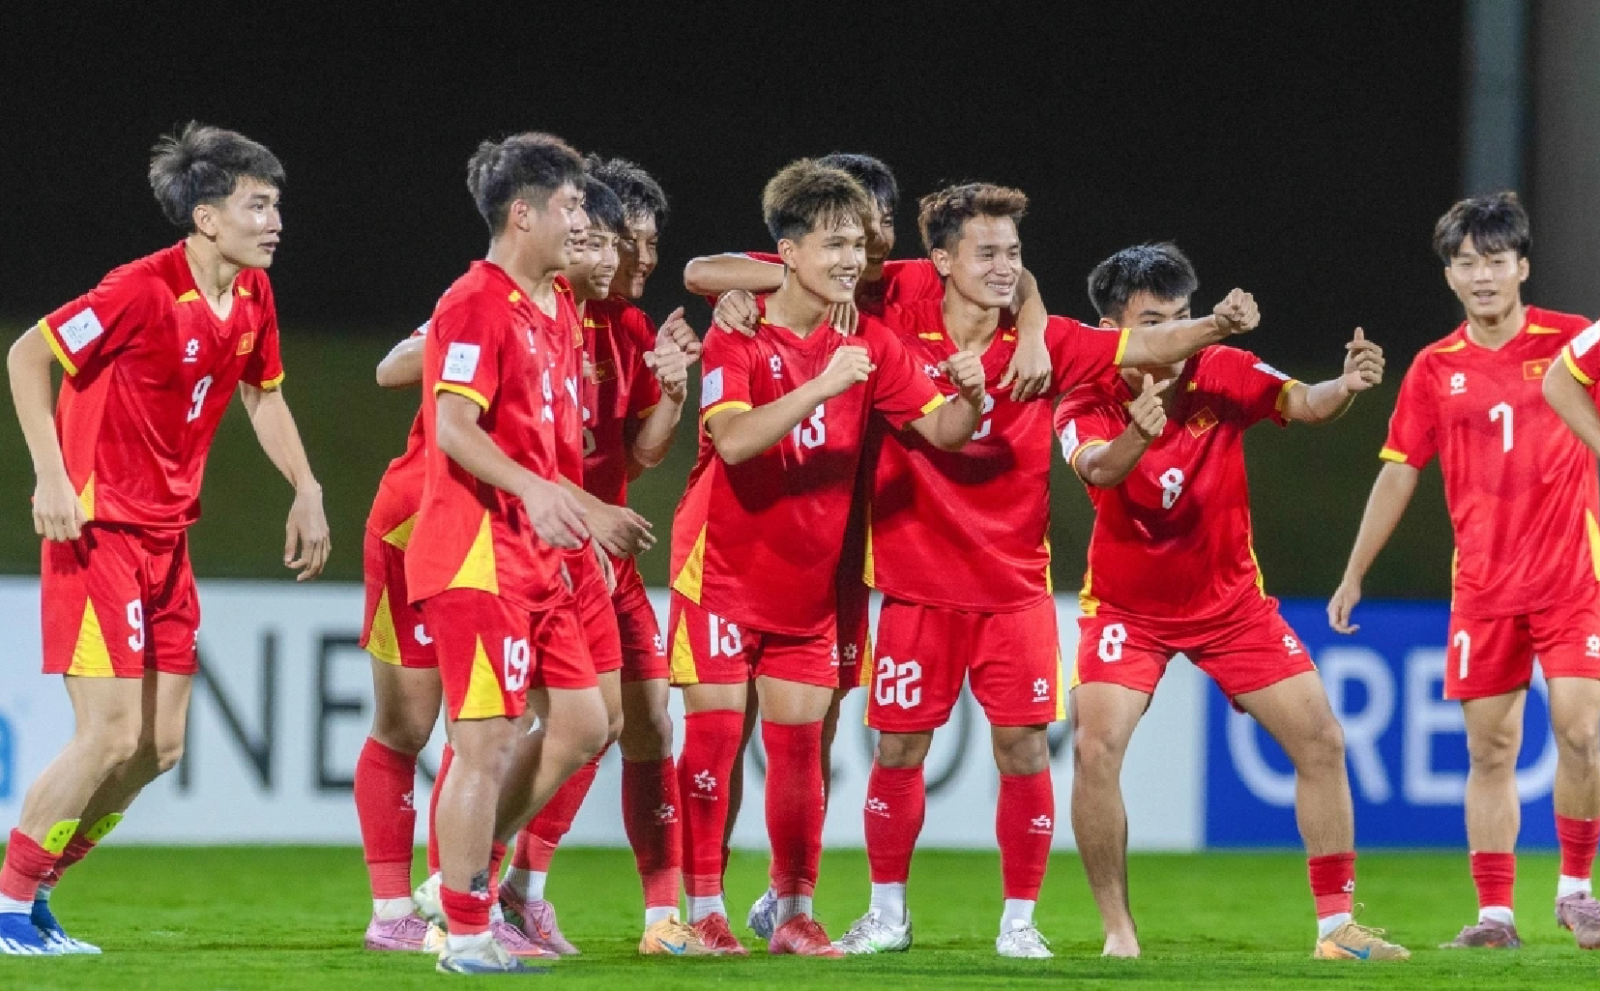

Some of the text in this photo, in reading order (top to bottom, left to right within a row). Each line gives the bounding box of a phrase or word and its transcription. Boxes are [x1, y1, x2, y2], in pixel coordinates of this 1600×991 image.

[187, 374, 213, 423] 9
[1159, 467, 1184, 509] 8
[126, 599, 145, 652] 9
[708, 611, 743, 657] 13
[1098, 623, 1127, 662] 8
[503, 636, 530, 691] 19
[876, 656, 921, 709] 22
